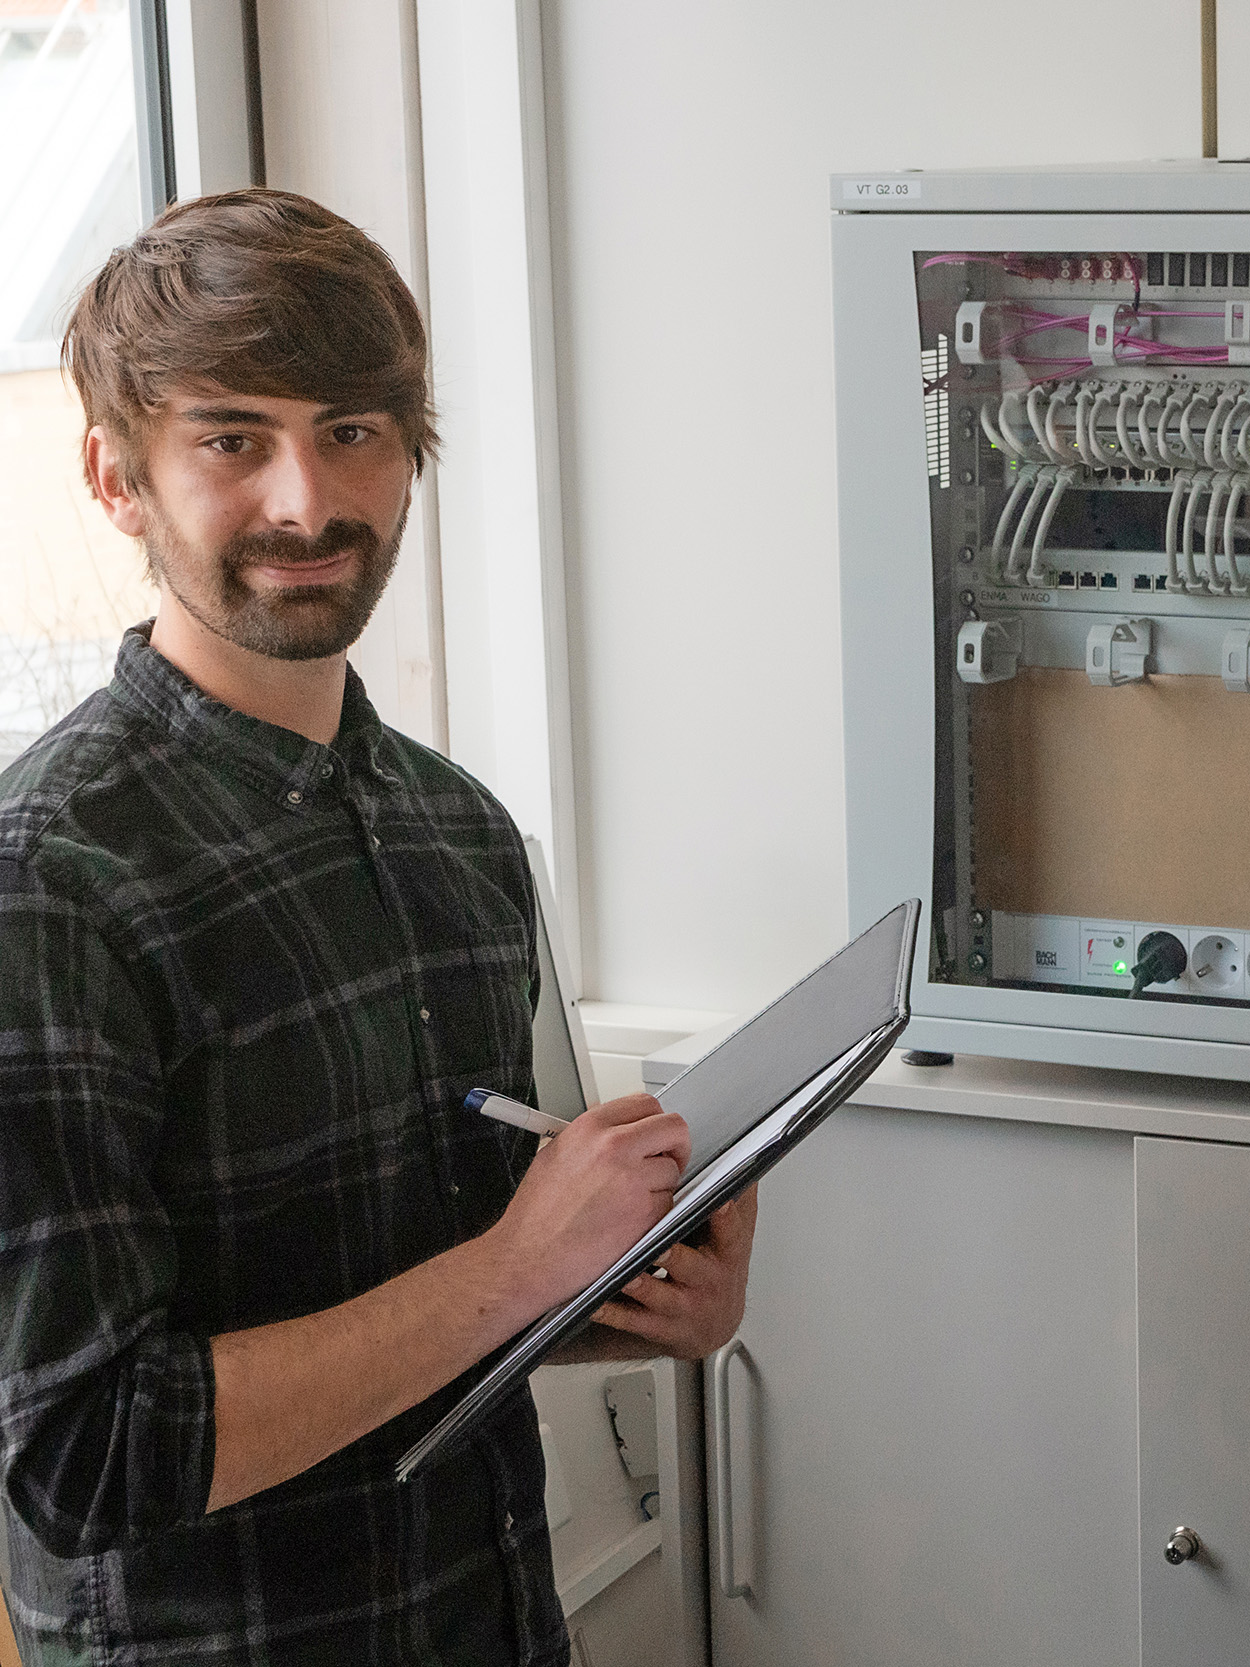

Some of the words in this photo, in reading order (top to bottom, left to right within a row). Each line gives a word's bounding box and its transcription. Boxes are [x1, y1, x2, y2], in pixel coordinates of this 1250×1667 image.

[856, 184, 872, 195] VT
[875, 184, 909, 195] G2.03
[1020, 592, 1050, 603] WAGO
